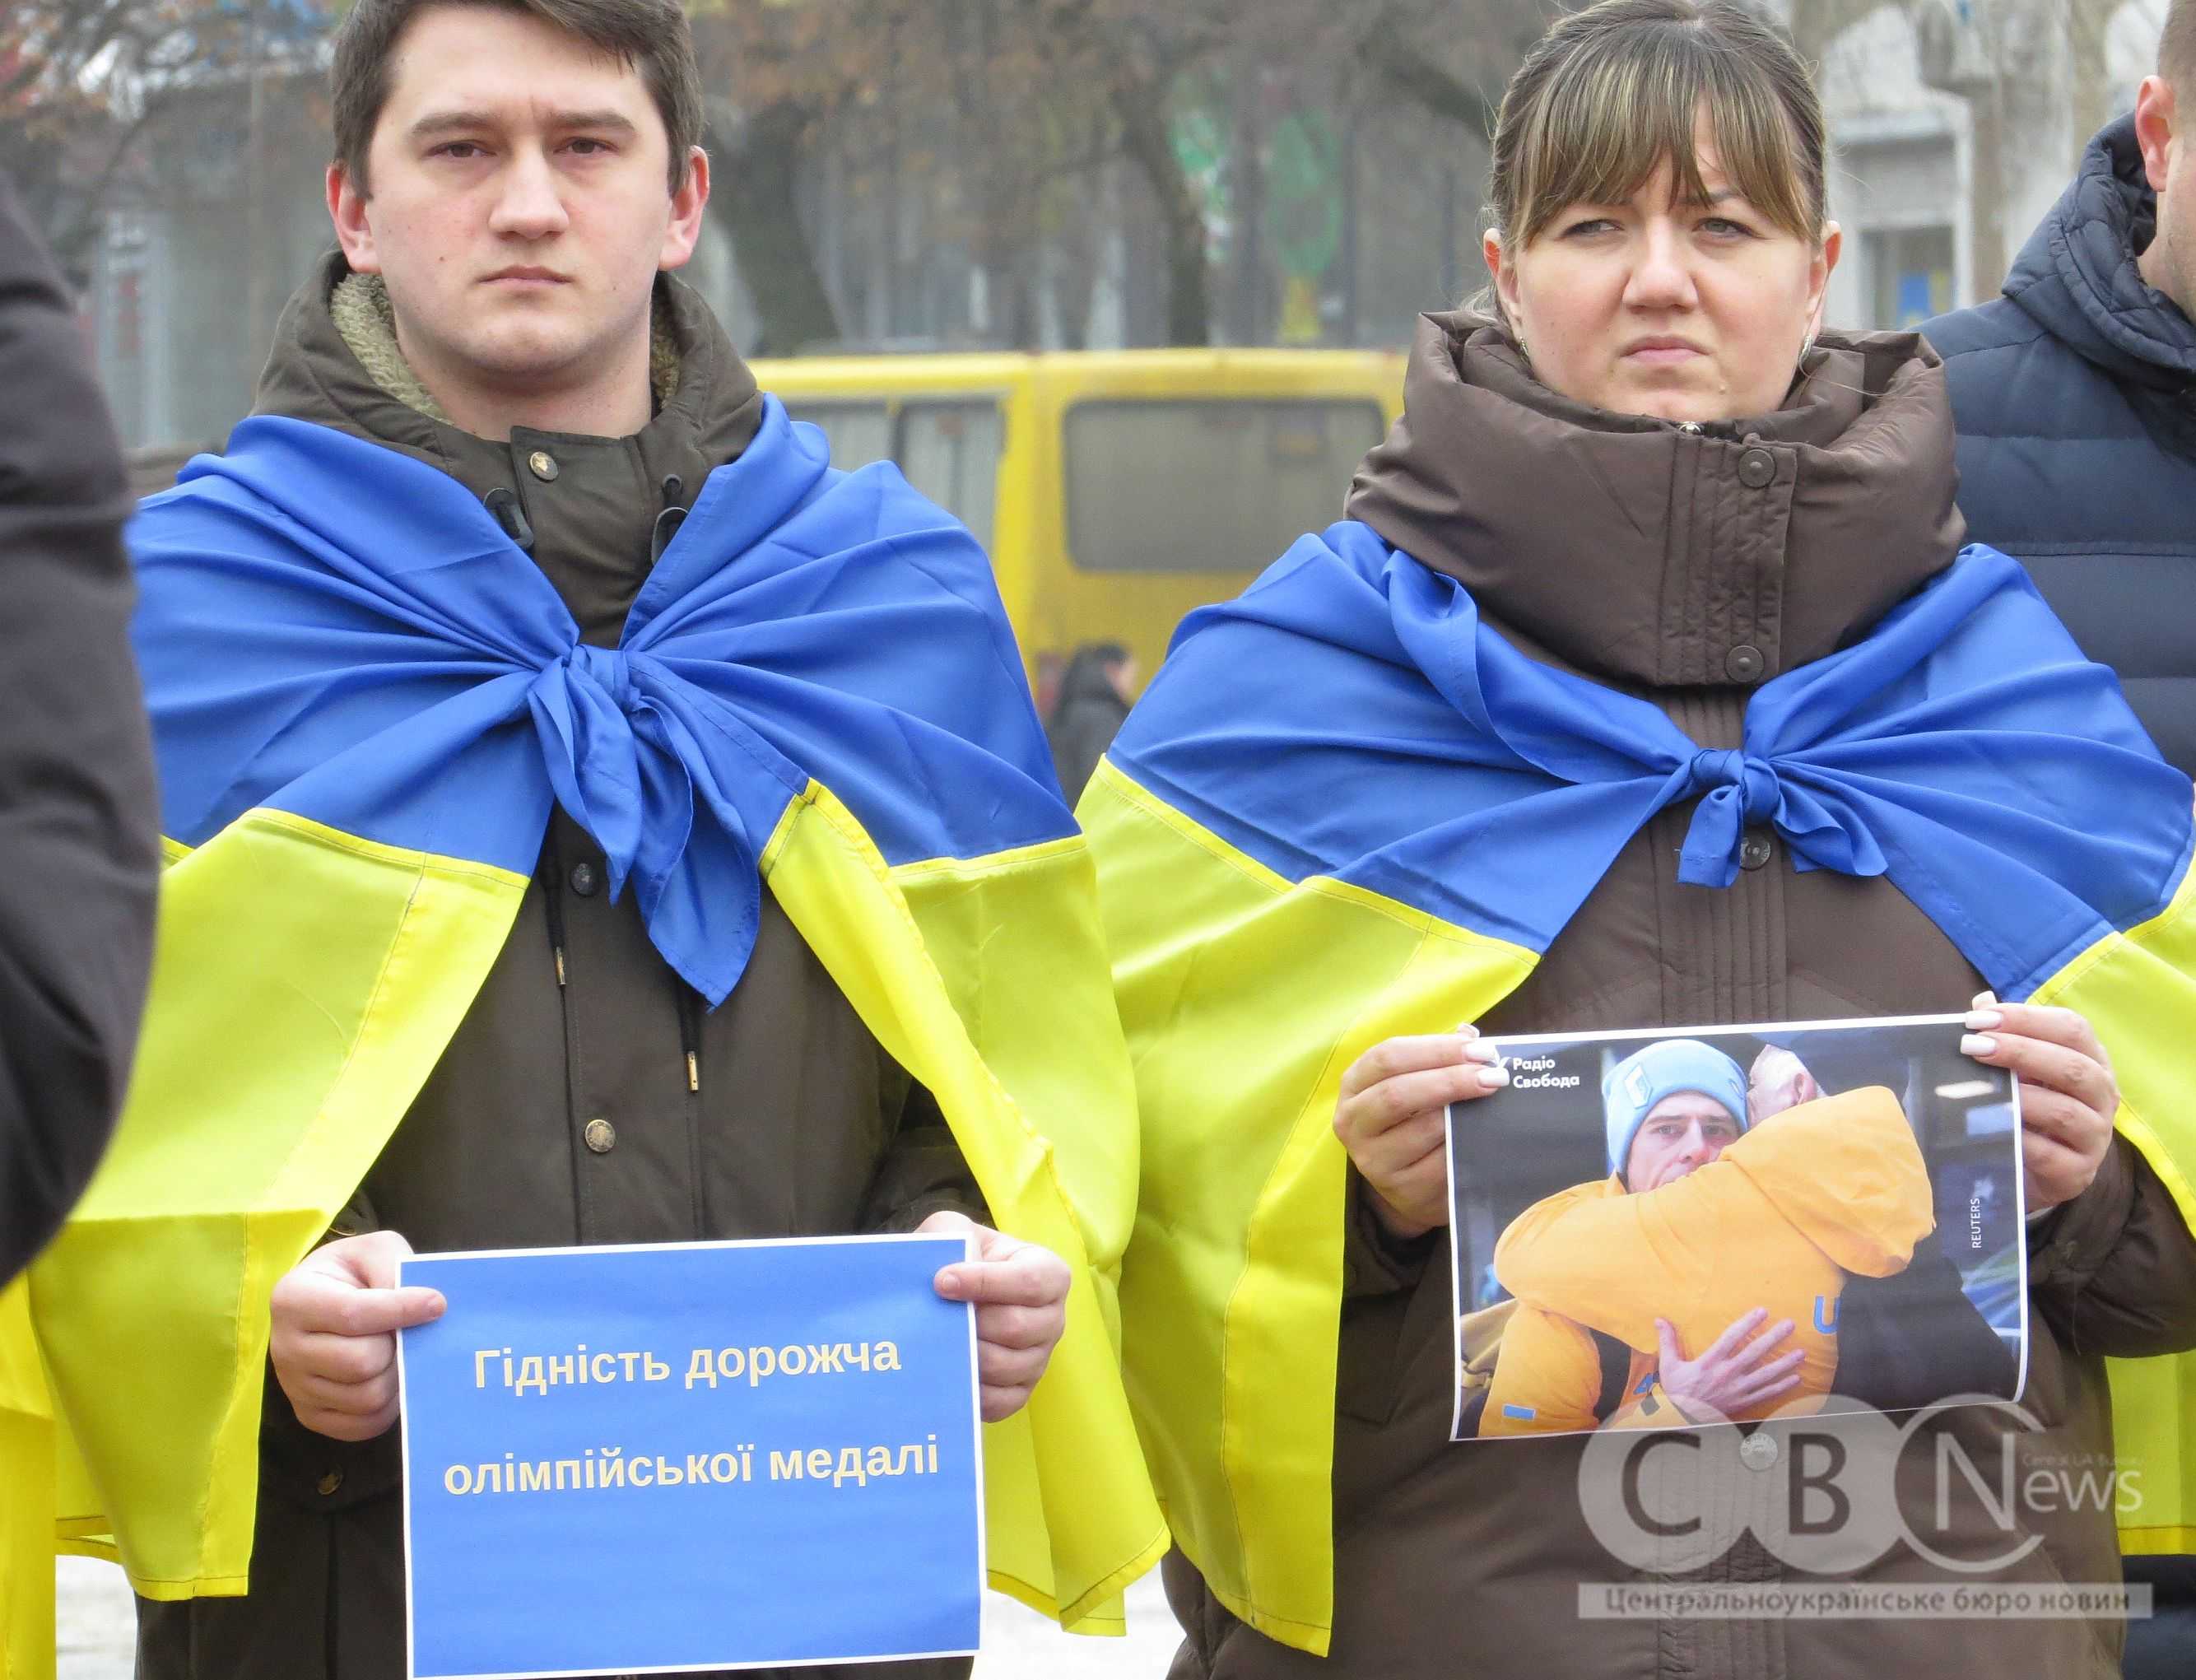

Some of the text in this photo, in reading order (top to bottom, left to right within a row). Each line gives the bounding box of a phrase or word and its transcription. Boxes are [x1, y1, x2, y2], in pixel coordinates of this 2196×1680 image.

[1513, 1055, 1556, 1072] Радіо
[1513, 1073, 1580, 1088] Свобода
[1970, 1198, 1982, 1249] REUTERS
[474, 1340, 901, 1397] Гідність дорожча
[443, 1435, 938, 1496] олімпійської медалі
